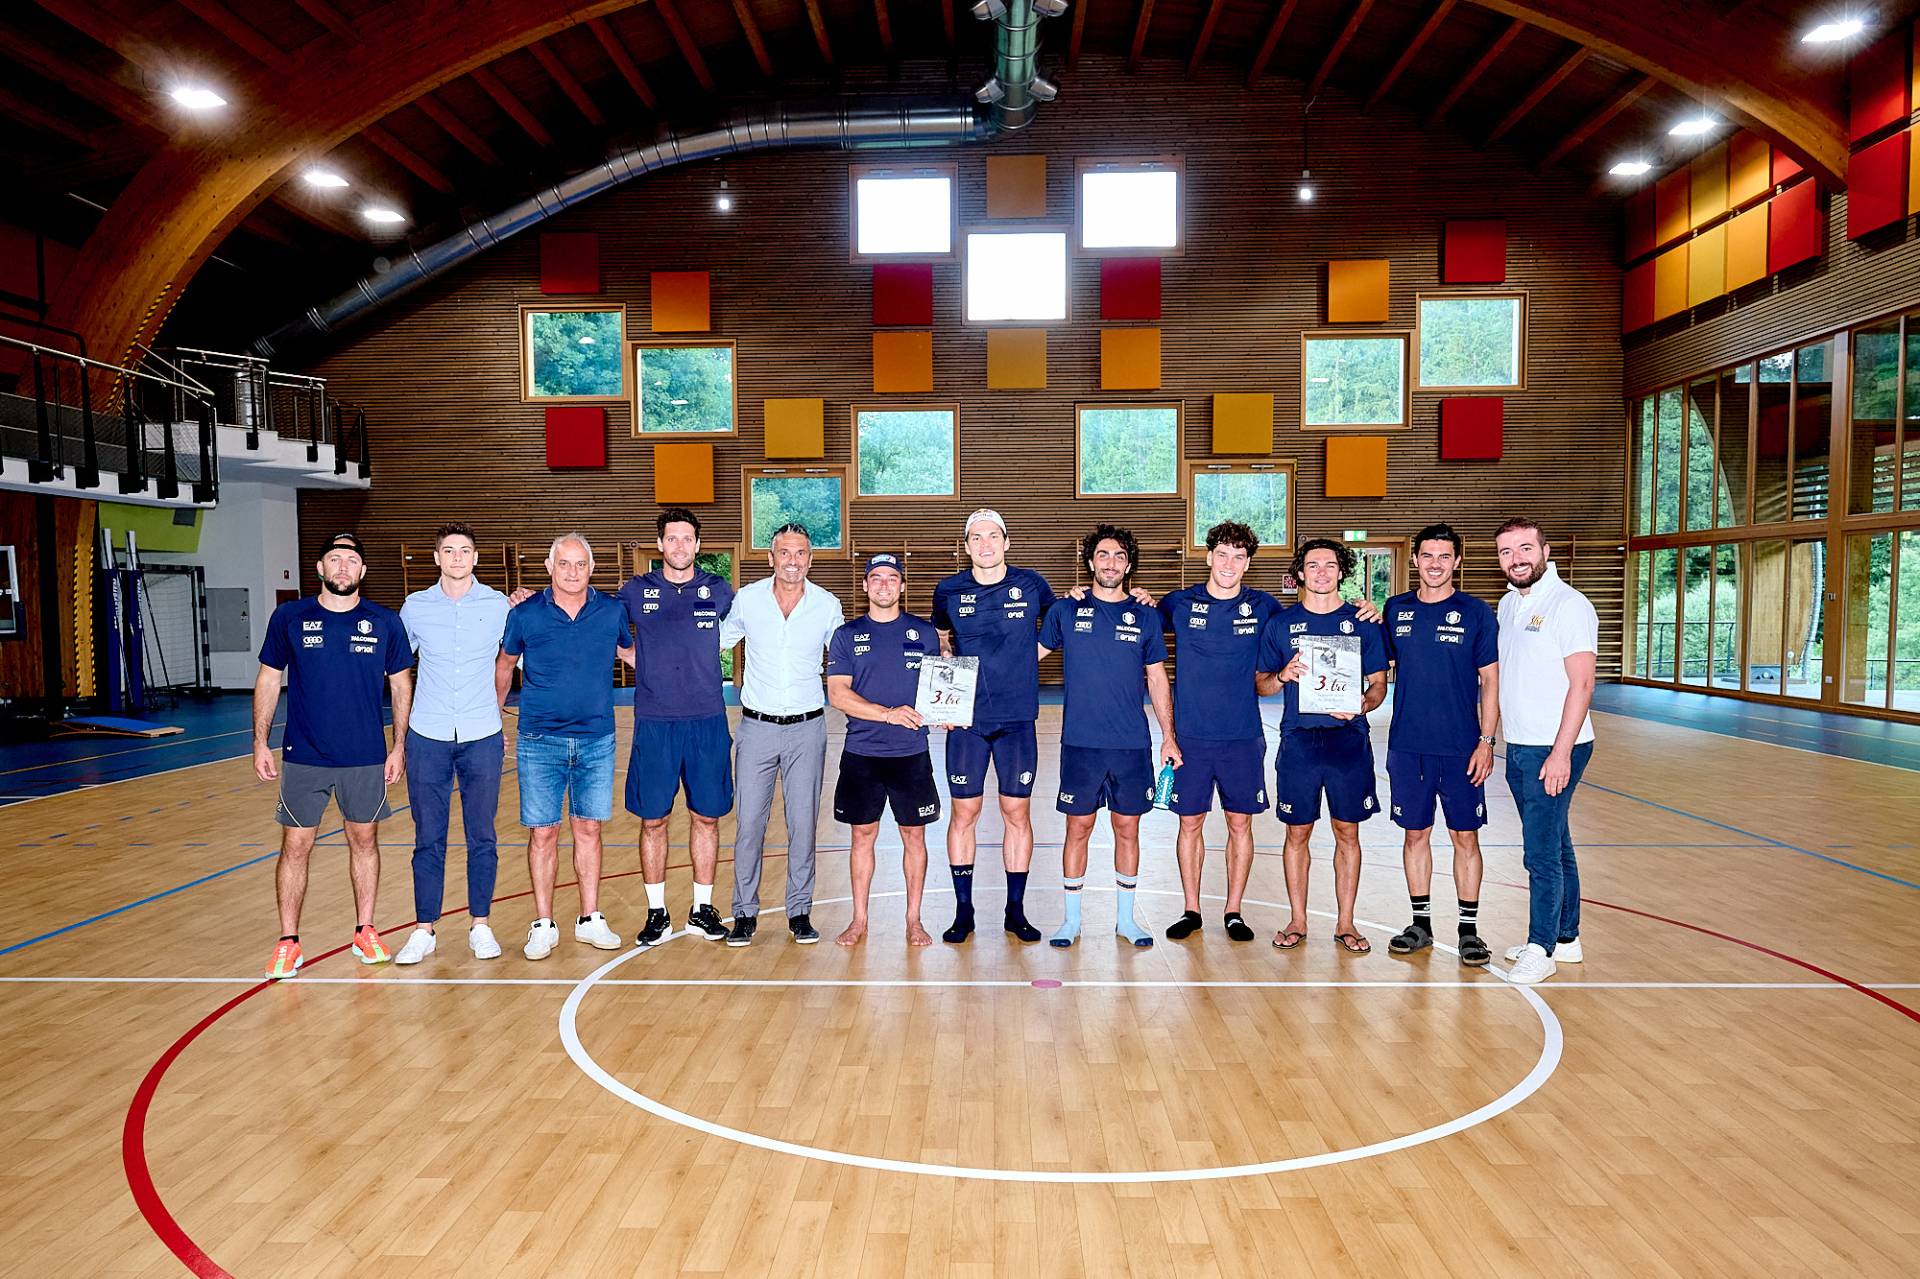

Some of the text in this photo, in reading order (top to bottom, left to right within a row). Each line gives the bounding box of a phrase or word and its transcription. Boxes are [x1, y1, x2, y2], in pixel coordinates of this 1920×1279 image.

[644, 589, 660, 598] EA7
[960, 595, 977, 603] EA7
[1077, 608, 1094, 616] EA7
[1192, 603, 1209, 613] EA7
[1398, 611, 1415, 620] EA7
[303, 621, 323, 630] EA7
[854, 633, 871, 641] EA7
[951, 775, 967, 784] EA7
[918, 804, 936, 816] EA7
